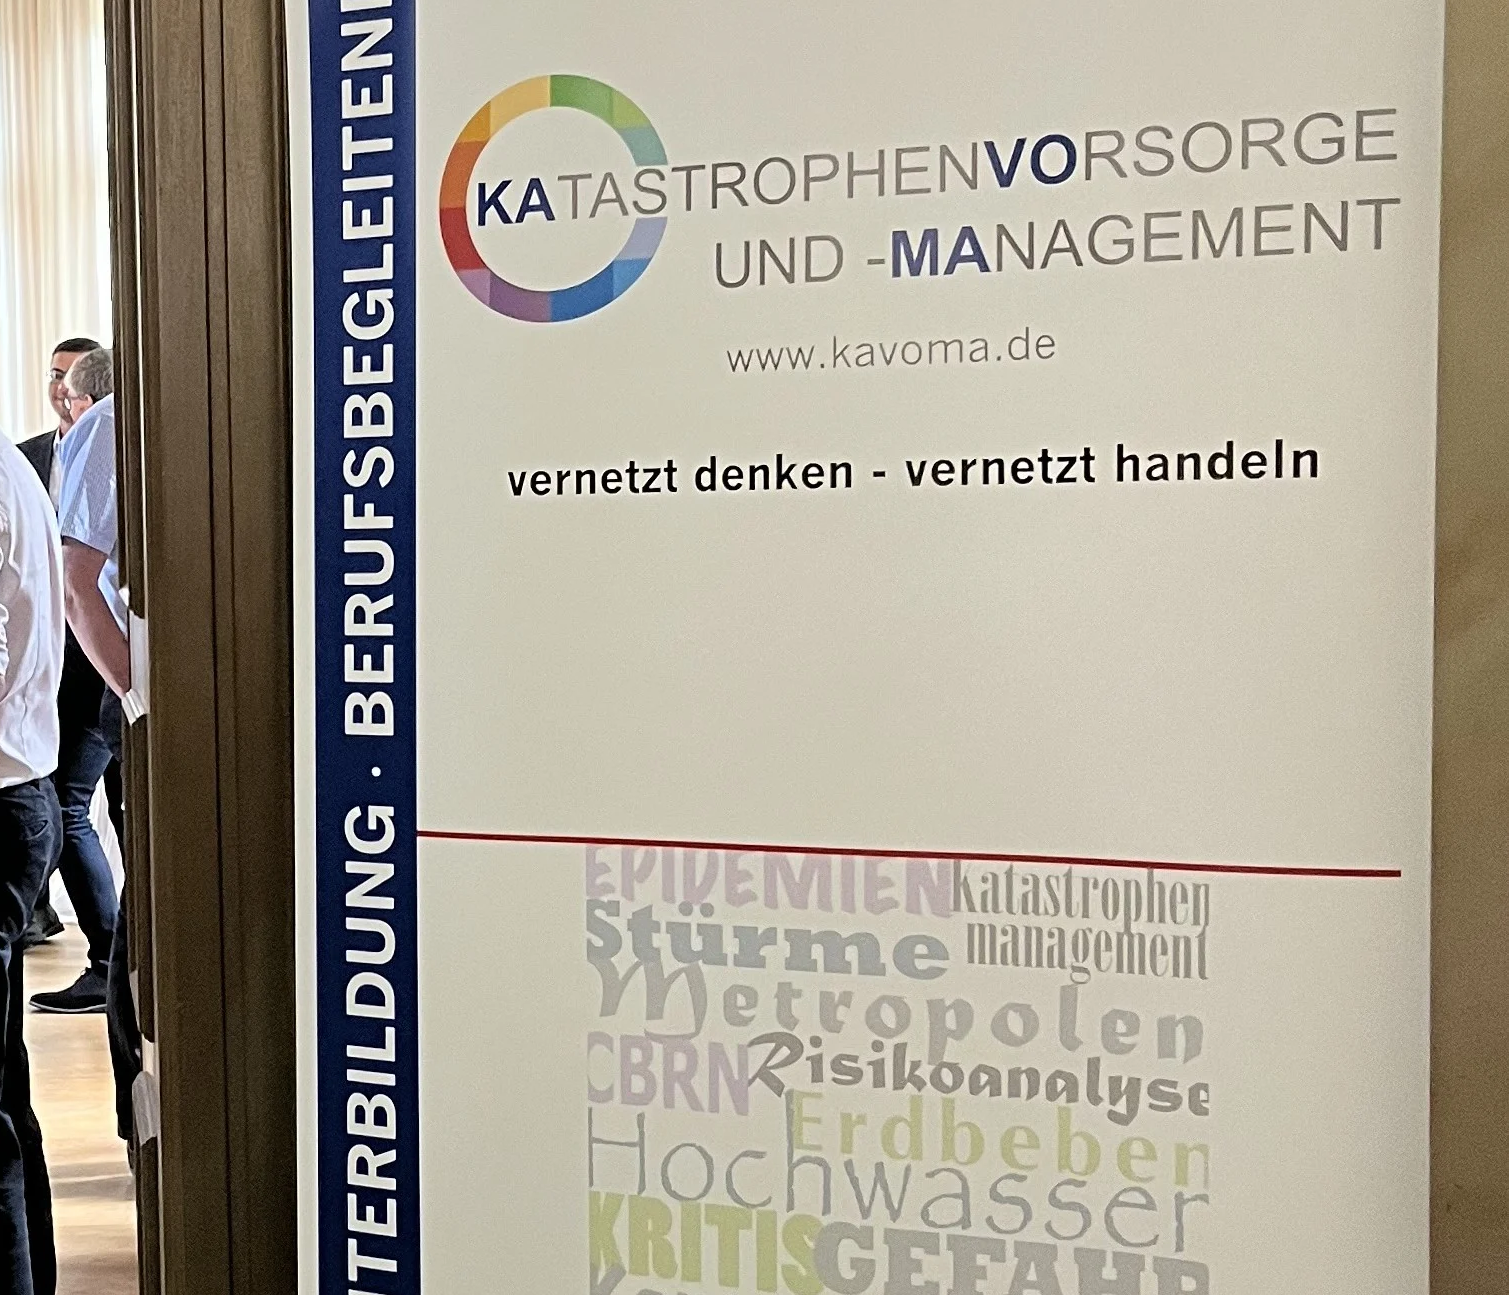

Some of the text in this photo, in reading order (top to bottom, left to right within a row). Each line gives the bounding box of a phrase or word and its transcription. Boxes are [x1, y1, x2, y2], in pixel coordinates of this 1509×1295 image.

[477, 107, 1399, 226] KATASTROPHENVORSORGE
[714, 198, 1401, 288] UND -MANAGEMENT
[727, 327, 1055, 373] www.kavoma.de
[508, 456, 678, 497] vernetzt
[694, 452, 853, 492] denken
[905, 446, 1096, 488] vernetzt
[1115, 442, 1320, 485] handeln
[586, 845, 1210, 929] EPIDEMIEN katastrophen
[586, 899, 1208, 984] Stürme management
[586, 959, 1204, 1062] Metropolen
[587, 1031, 1209, 1125] CBRN Risikoanalyse
[588, 1089, 1210, 1247] Hochwasser
[792, 1089, 1210, 1189] Erdbeben
